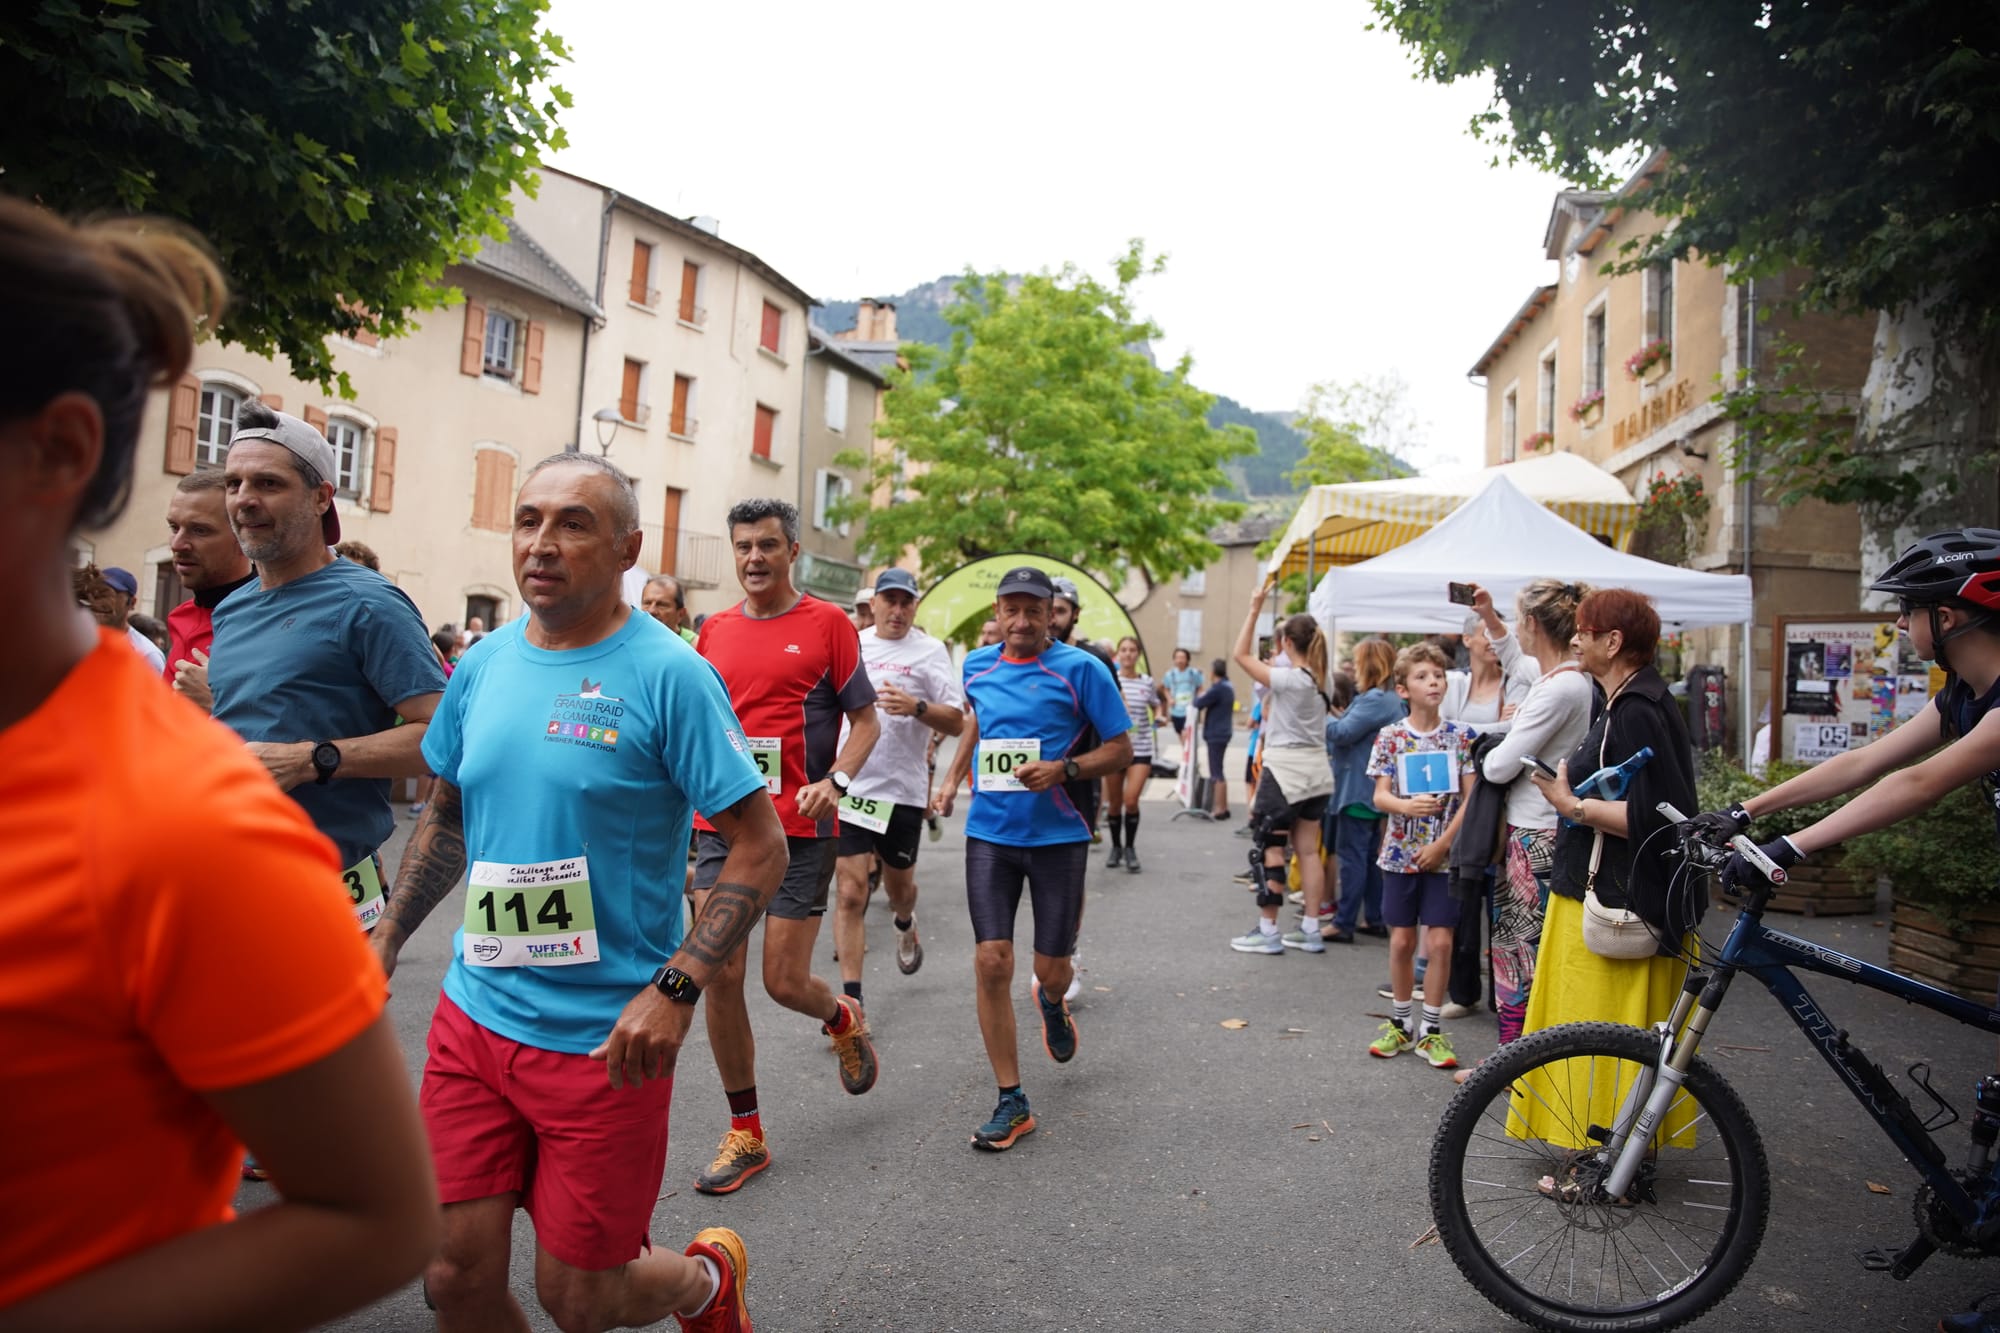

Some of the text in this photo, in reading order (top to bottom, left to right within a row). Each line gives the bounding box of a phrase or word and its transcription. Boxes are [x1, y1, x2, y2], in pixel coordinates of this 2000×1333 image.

[554, 698, 624, 717] GRAND RAID
[550, 709, 621, 729] de CAMARGUE
[543, 735, 617, 753] FINISHER MARATHON
[1820, 727, 1847, 744] 05
[1421, 764, 1432, 782] 1
[510, 862, 575, 877] Challenge des
[478, 889, 573, 932] 114
[526, 942, 569, 953] TUFF'S
[532, 950, 574, 959] Aventure
[1528, 1304, 1661, 1330] SCHWALBE
